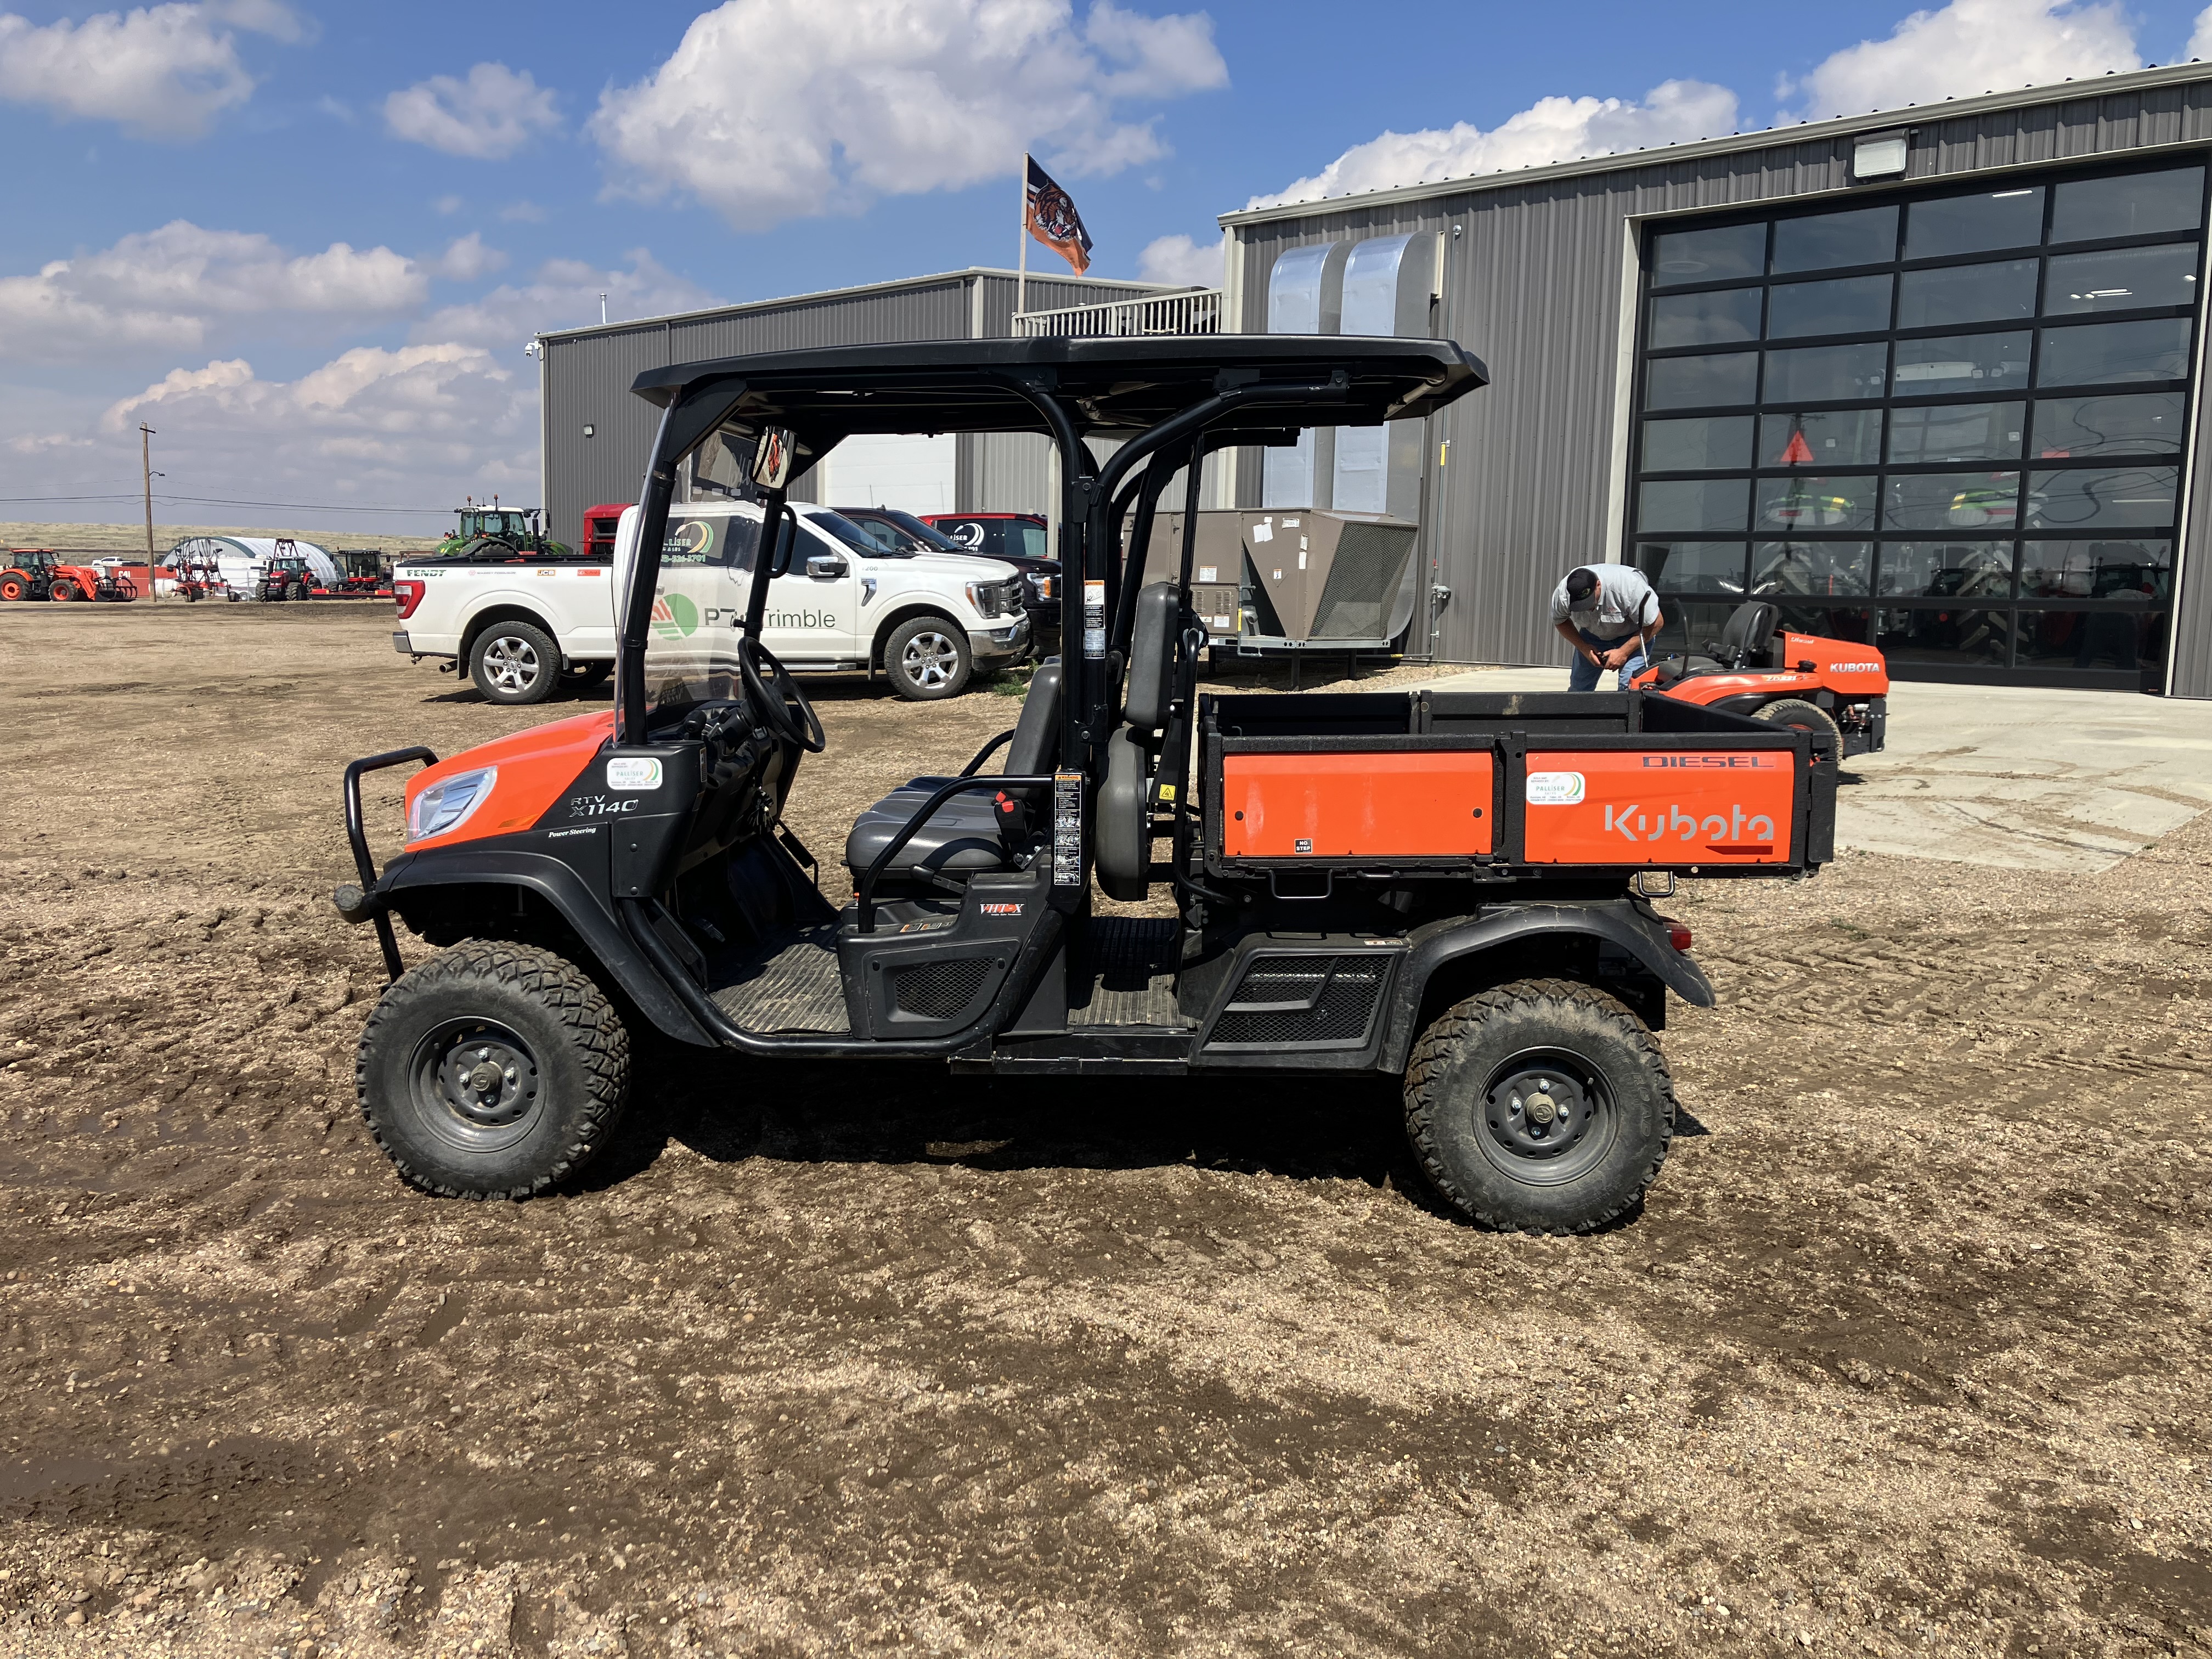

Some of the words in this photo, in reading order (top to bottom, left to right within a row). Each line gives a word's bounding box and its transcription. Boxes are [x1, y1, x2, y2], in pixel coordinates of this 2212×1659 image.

[764, 608, 836, 628] rimble
[1830, 663, 1880, 673] KUBOTA
[1643, 757, 1774, 767] DIESEL
[571, 795, 606, 805] RTV
[569, 799, 639, 817] X1140
[1605, 804, 1774, 840] Kubota
[980, 904, 1025, 914] VHT-X
